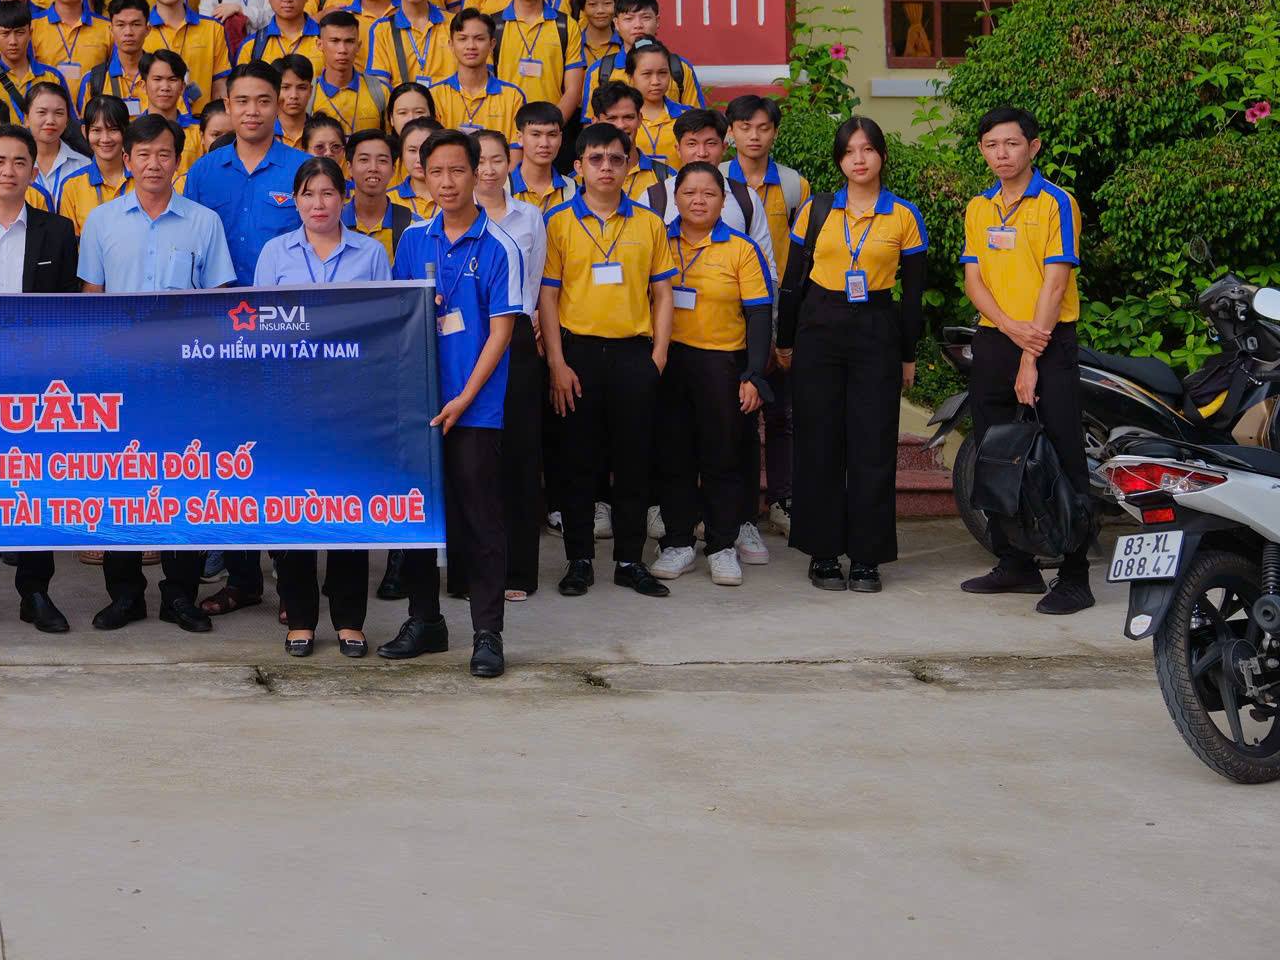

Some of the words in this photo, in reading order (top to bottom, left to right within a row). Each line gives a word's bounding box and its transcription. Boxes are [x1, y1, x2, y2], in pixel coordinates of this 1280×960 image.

[260, 306, 305, 322] PVI
[182, 340, 214, 358] BẢO
[220, 336, 256, 358] HIỂM
[262, 344, 285, 357] PVI
[291, 340, 318, 357] TÂY
[324, 344, 358, 357] NAM
[48, 440, 157, 480] CHUYỂN
[164, 439, 210, 479] ĐỔI
[216, 442, 256, 479] SỐ
[47, 498, 104, 532] TRỢ
[110, 486, 180, 525] THẮP
[186, 490, 259, 524] SÁNG
[264, 489, 363, 524] ĐƯỜNG
[369, 488, 425, 525] QUÊ
[1124, 534, 1170, 556] 83-XL
[1113, 555, 1176, 578] 088.47
